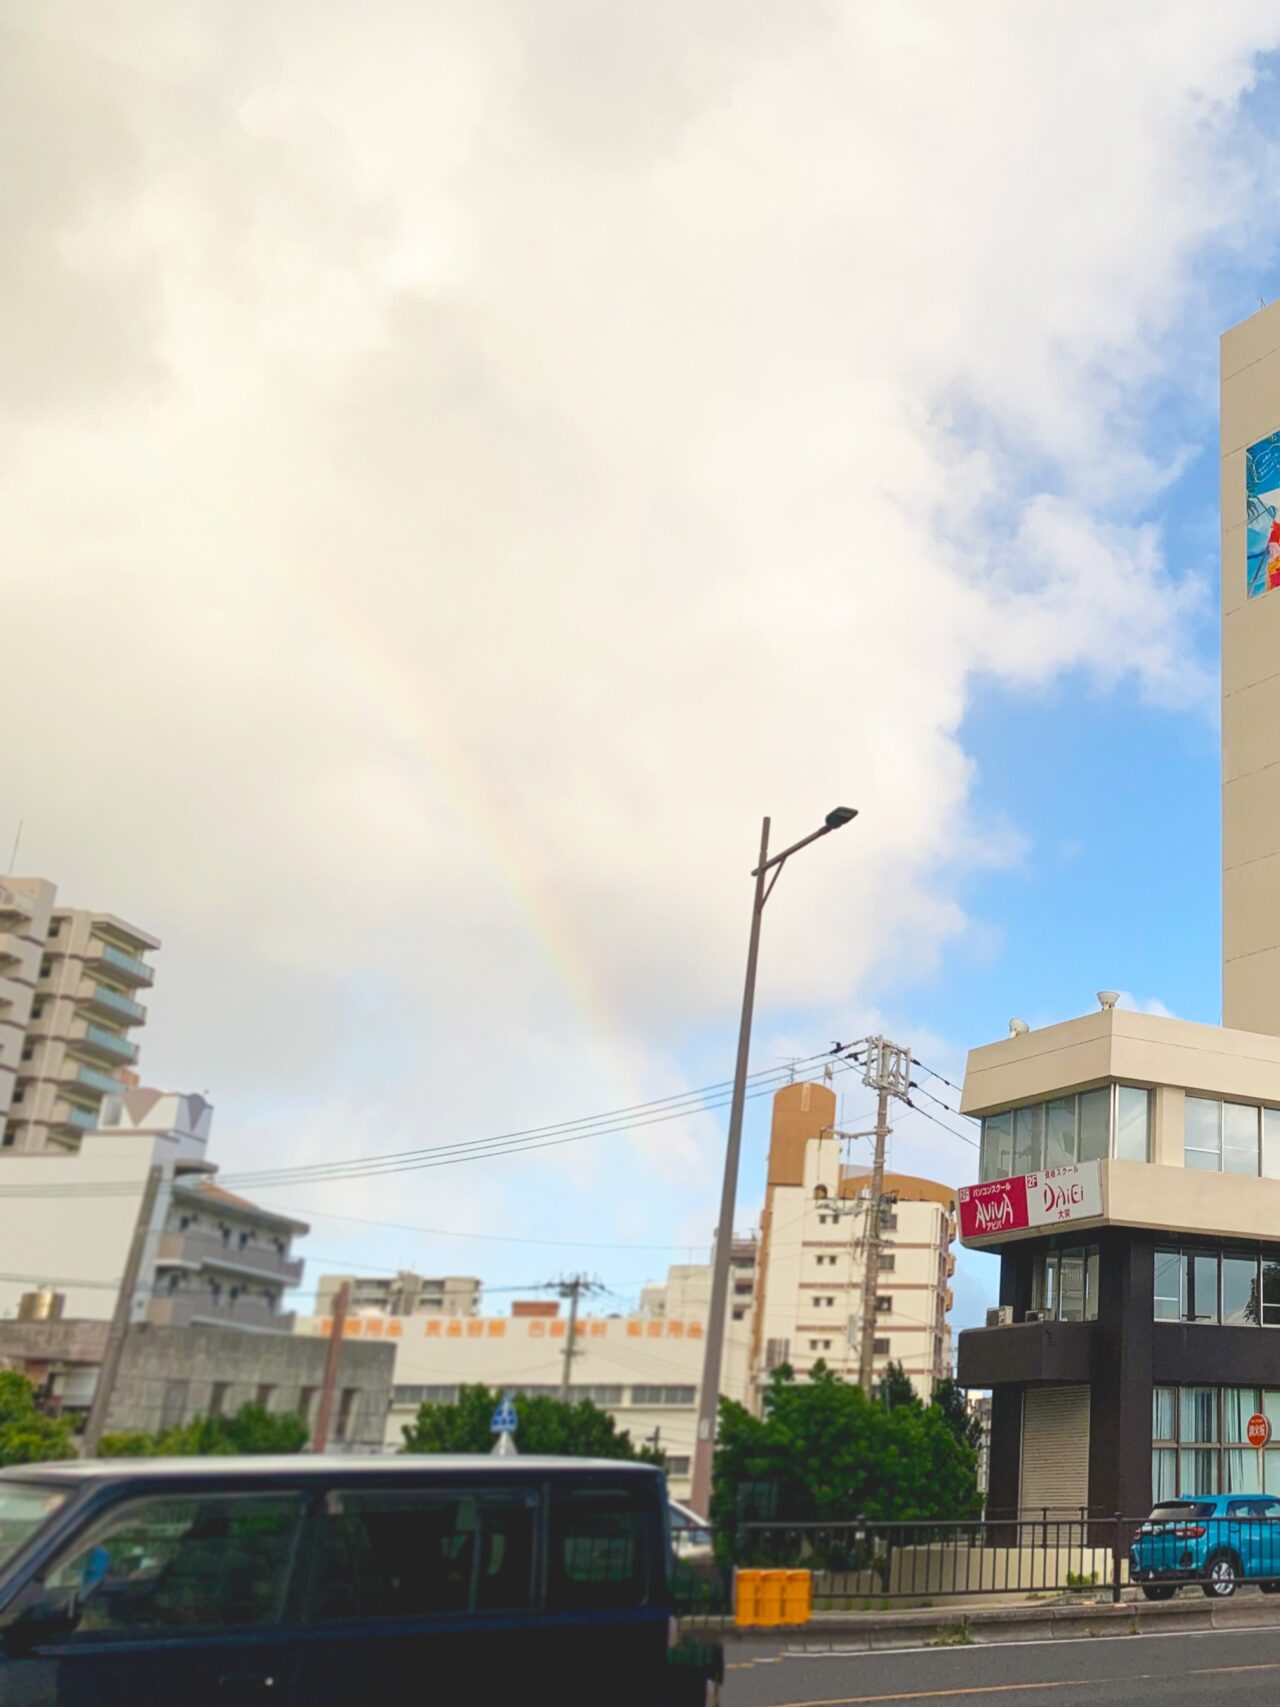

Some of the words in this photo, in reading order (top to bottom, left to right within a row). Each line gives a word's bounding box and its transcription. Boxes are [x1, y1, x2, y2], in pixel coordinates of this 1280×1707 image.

[1045, 1166, 1079, 1180] 資格スクール
[1027, 1175, 1037, 1188] 2F
[960, 1189, 969, 1202] 2F
[973, 1183, 1011, 1198] パソコンスクール
[1058, 1208, 1071, 1220] 大栄
[986, 1221, 1002, 1231] アビバ
